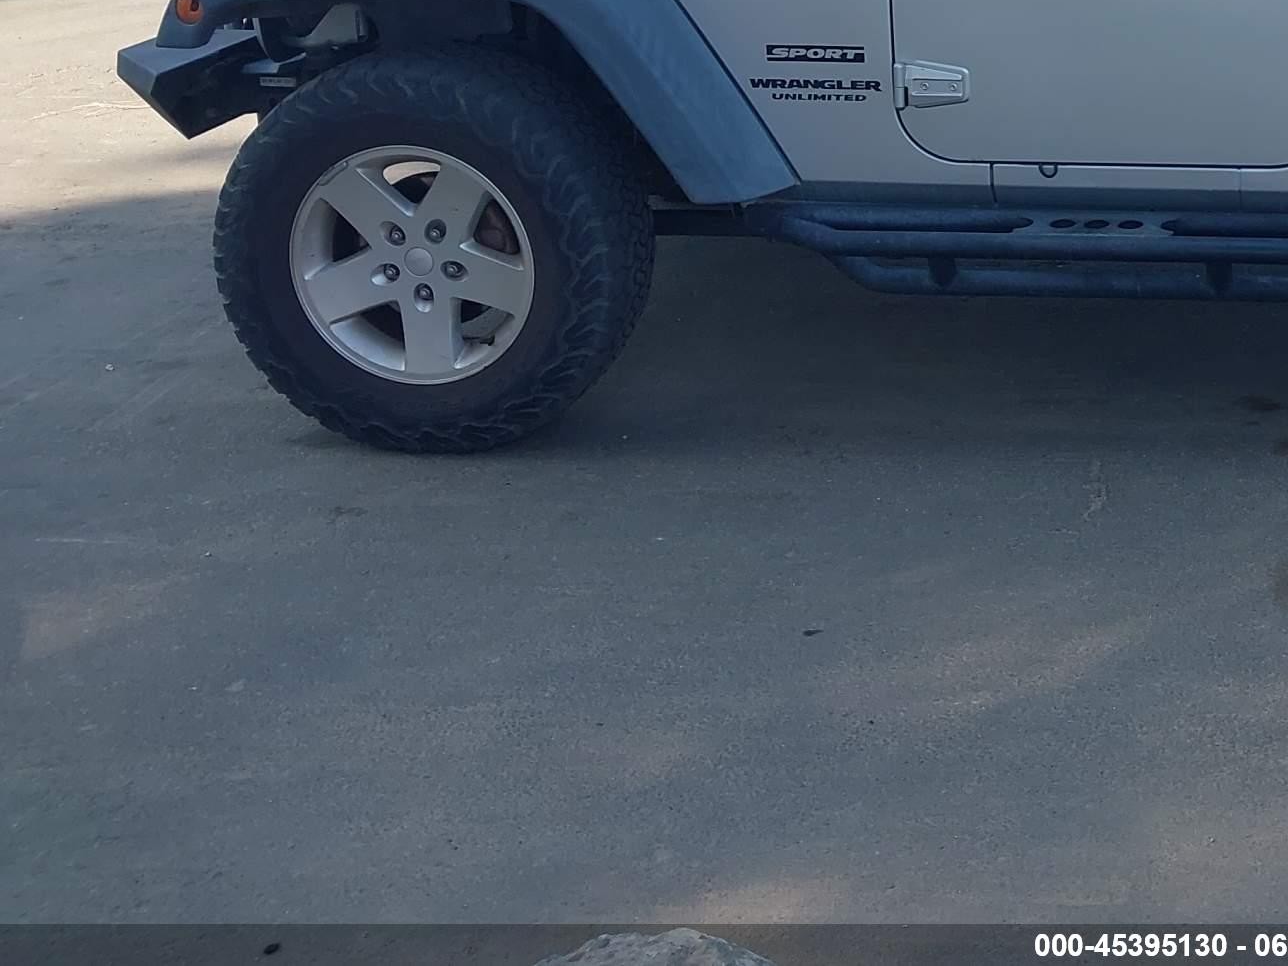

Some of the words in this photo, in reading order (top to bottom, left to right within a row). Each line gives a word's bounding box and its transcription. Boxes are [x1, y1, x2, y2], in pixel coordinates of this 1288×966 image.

[767, 47, 865, 60] SPORT
[749, 78, 882, 92] WRANGLER
[771, 93, 867, 102] UNLIMITED
